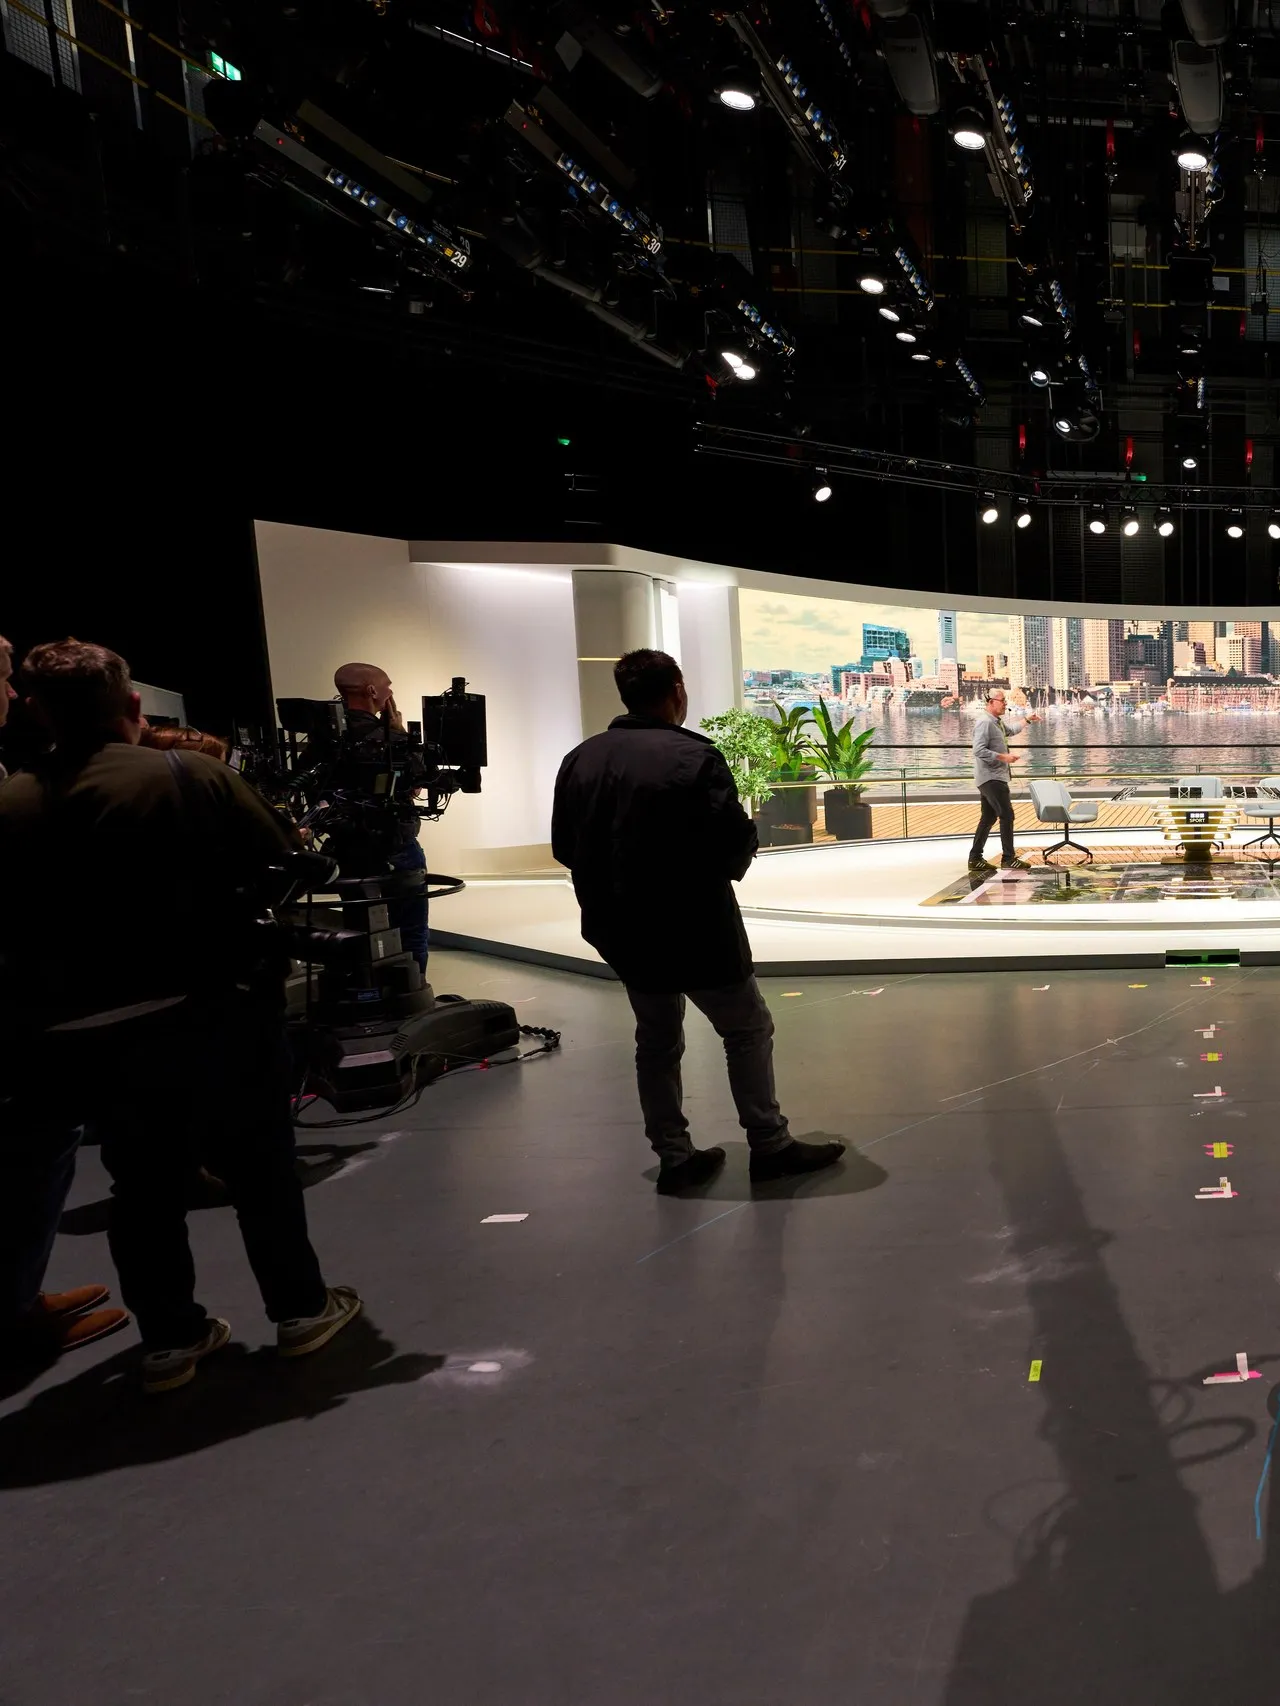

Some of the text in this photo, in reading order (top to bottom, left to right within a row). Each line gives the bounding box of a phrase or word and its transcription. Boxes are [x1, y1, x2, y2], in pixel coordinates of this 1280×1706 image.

[835, 154, 847, 170] 31
[647, 238, 661, 254] 30
[451, 251, 467, 268] 29
